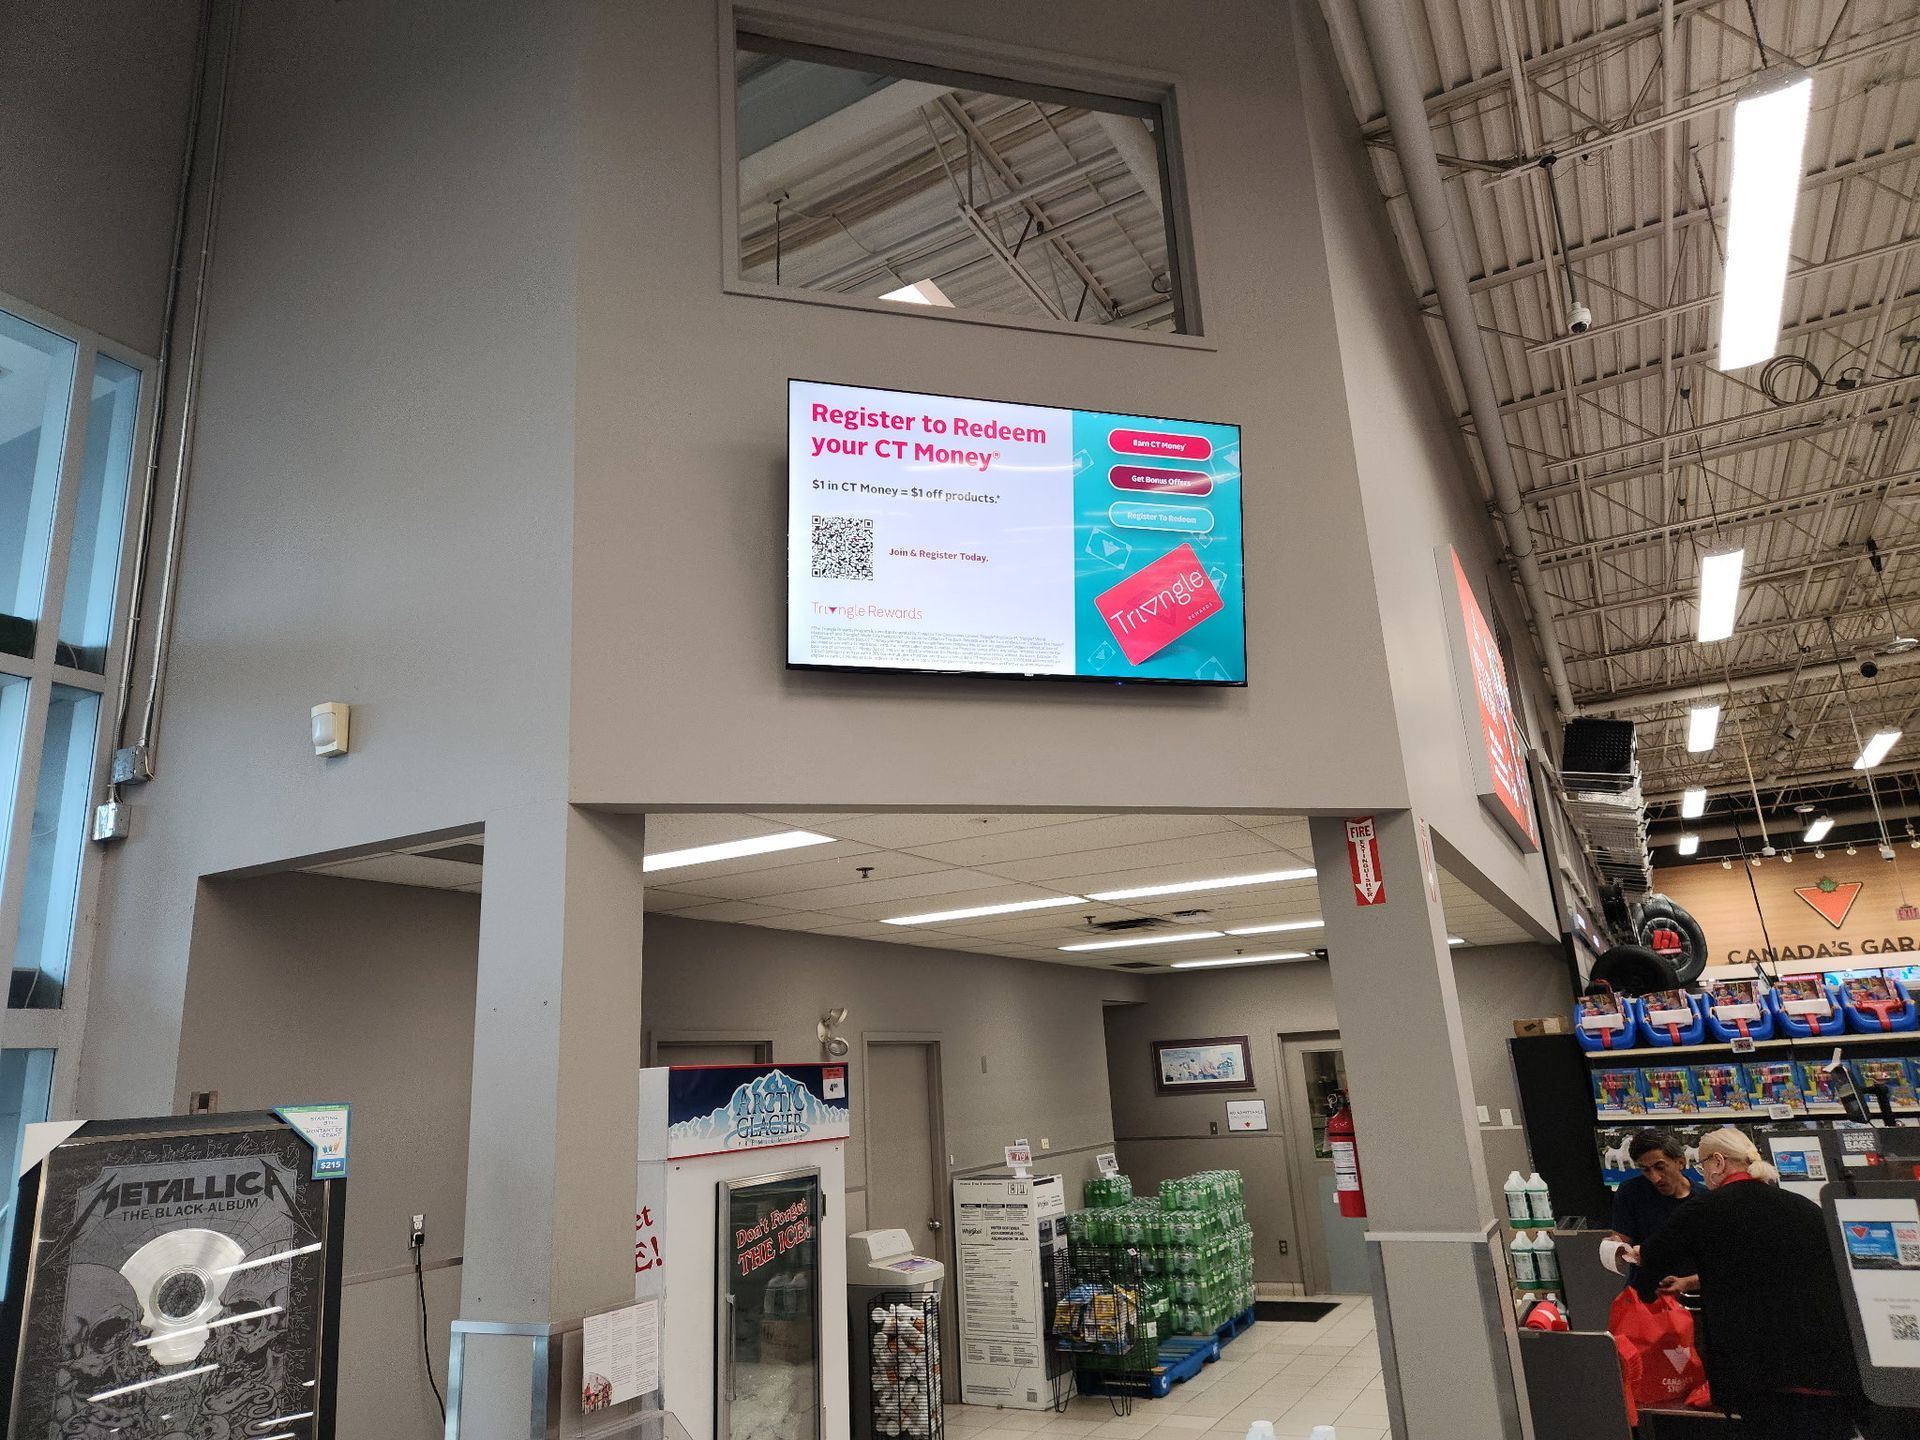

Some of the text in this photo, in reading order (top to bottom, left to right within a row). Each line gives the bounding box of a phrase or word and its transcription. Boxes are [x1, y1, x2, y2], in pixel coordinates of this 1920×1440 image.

[811, 403, 1047, 444] Register to Redeem
[811, 436, 1000, 472] your CT Money®
[1132, 439, 1150, 447] Earn
[1150, 440, 1161, 448] CT
[811, 479, 825, 490] $1
[827, 480, 839, 491] in
[841, 482, 857, 492] CT
[860, 483, 899, 498] Money
[911, 486, 923, 498] $1
[925, 488, 943, 499] off
[1131, 474, 1192, 487] Get Bonus Offers
[1127, 511, 1197, 524] Register To Redeem
[888, 548, 989, 564] Join & Register Today.
[867, 605, 923, 620] Rewards
[1349, 825, 1372, 839] FIRE
[1727, 936, 1920, 966] CANADA'S GAR
[736, 1083, 806, 1116] ARCTIC
[736, 1113, 806, 1139] GLACIER
[1844, 1140, 1874, 1150] BAGS
[320, 1161, 342, 1170] $215
[55, 1157, 315, 1243] METALLICA
[121, 1197, 259, 1222] THE BLACK ALBUM
[735, 1197, 808, 1249] Don't Forget
[737, 1216, 811, 1276] THE ICE!
